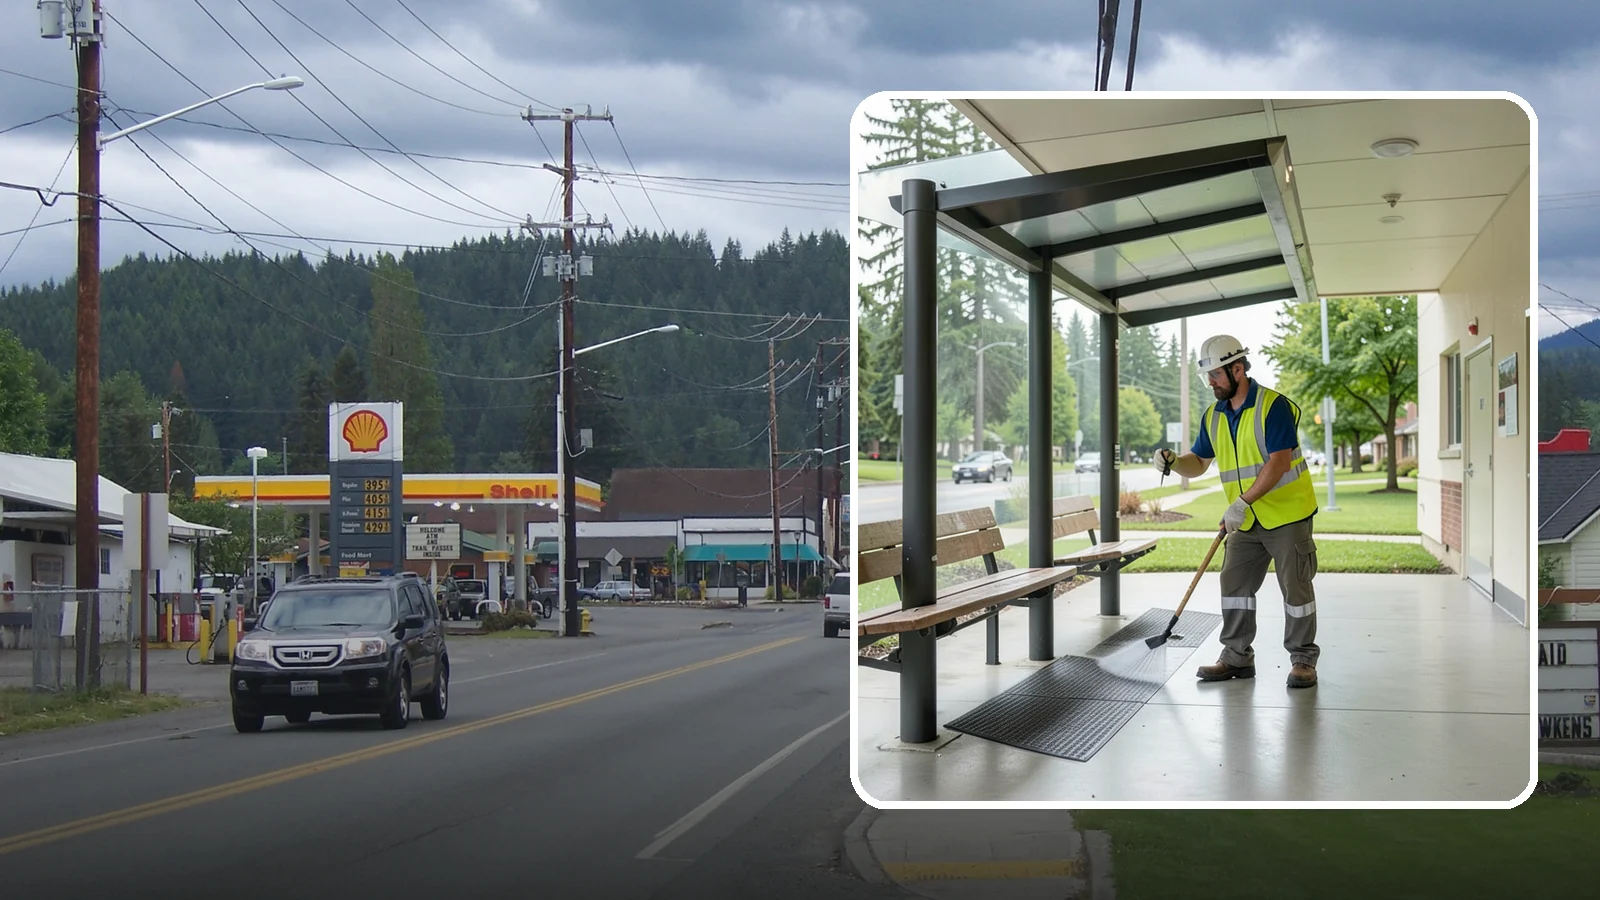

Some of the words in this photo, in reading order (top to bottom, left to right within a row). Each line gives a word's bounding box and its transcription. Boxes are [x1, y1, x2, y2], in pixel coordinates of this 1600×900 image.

[366, 480, 383, 490] 395
[490, 484, 547, 499] Shell
[366, 494, 383, 504] 405
[366, 508, 383, 518] 415
[366, 522, 383, 533] 429
[1539, 643, 1567, 665] AID
